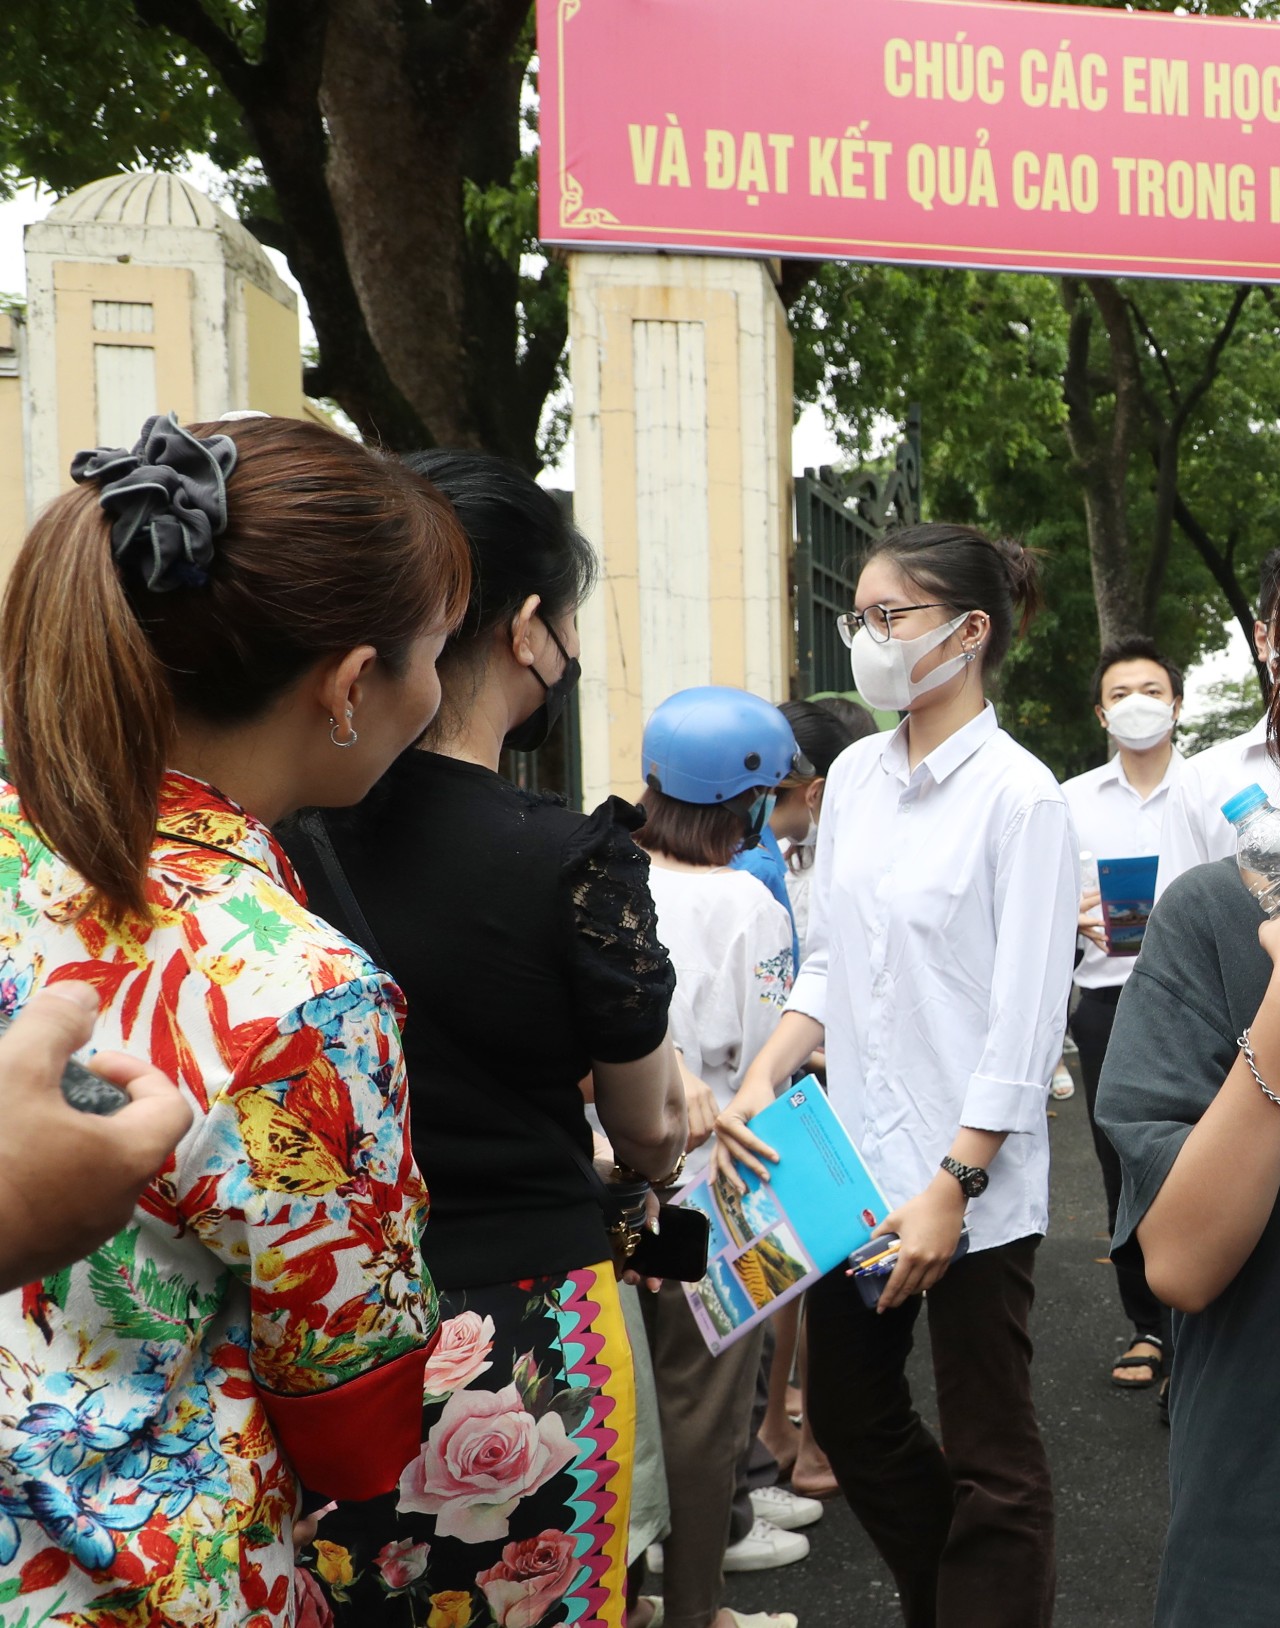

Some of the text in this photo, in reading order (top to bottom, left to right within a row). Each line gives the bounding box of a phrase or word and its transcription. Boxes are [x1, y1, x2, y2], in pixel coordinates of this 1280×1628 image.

[884, 32, 1005, 104] CHÚC
[1020, 39, 1108, 111] CÁC
[1123, 56, 1190, 116] EM
[628, 113, 691, 187] VÀ
[704, 129, 795, 205] ĐẠT
[809, 120, 893, 201] KẾT
[907, 128, 999, 210] QUẢ
[1012, 150, 1099, 213] CAO
[1112, 156, 1256, 222] TRONG
